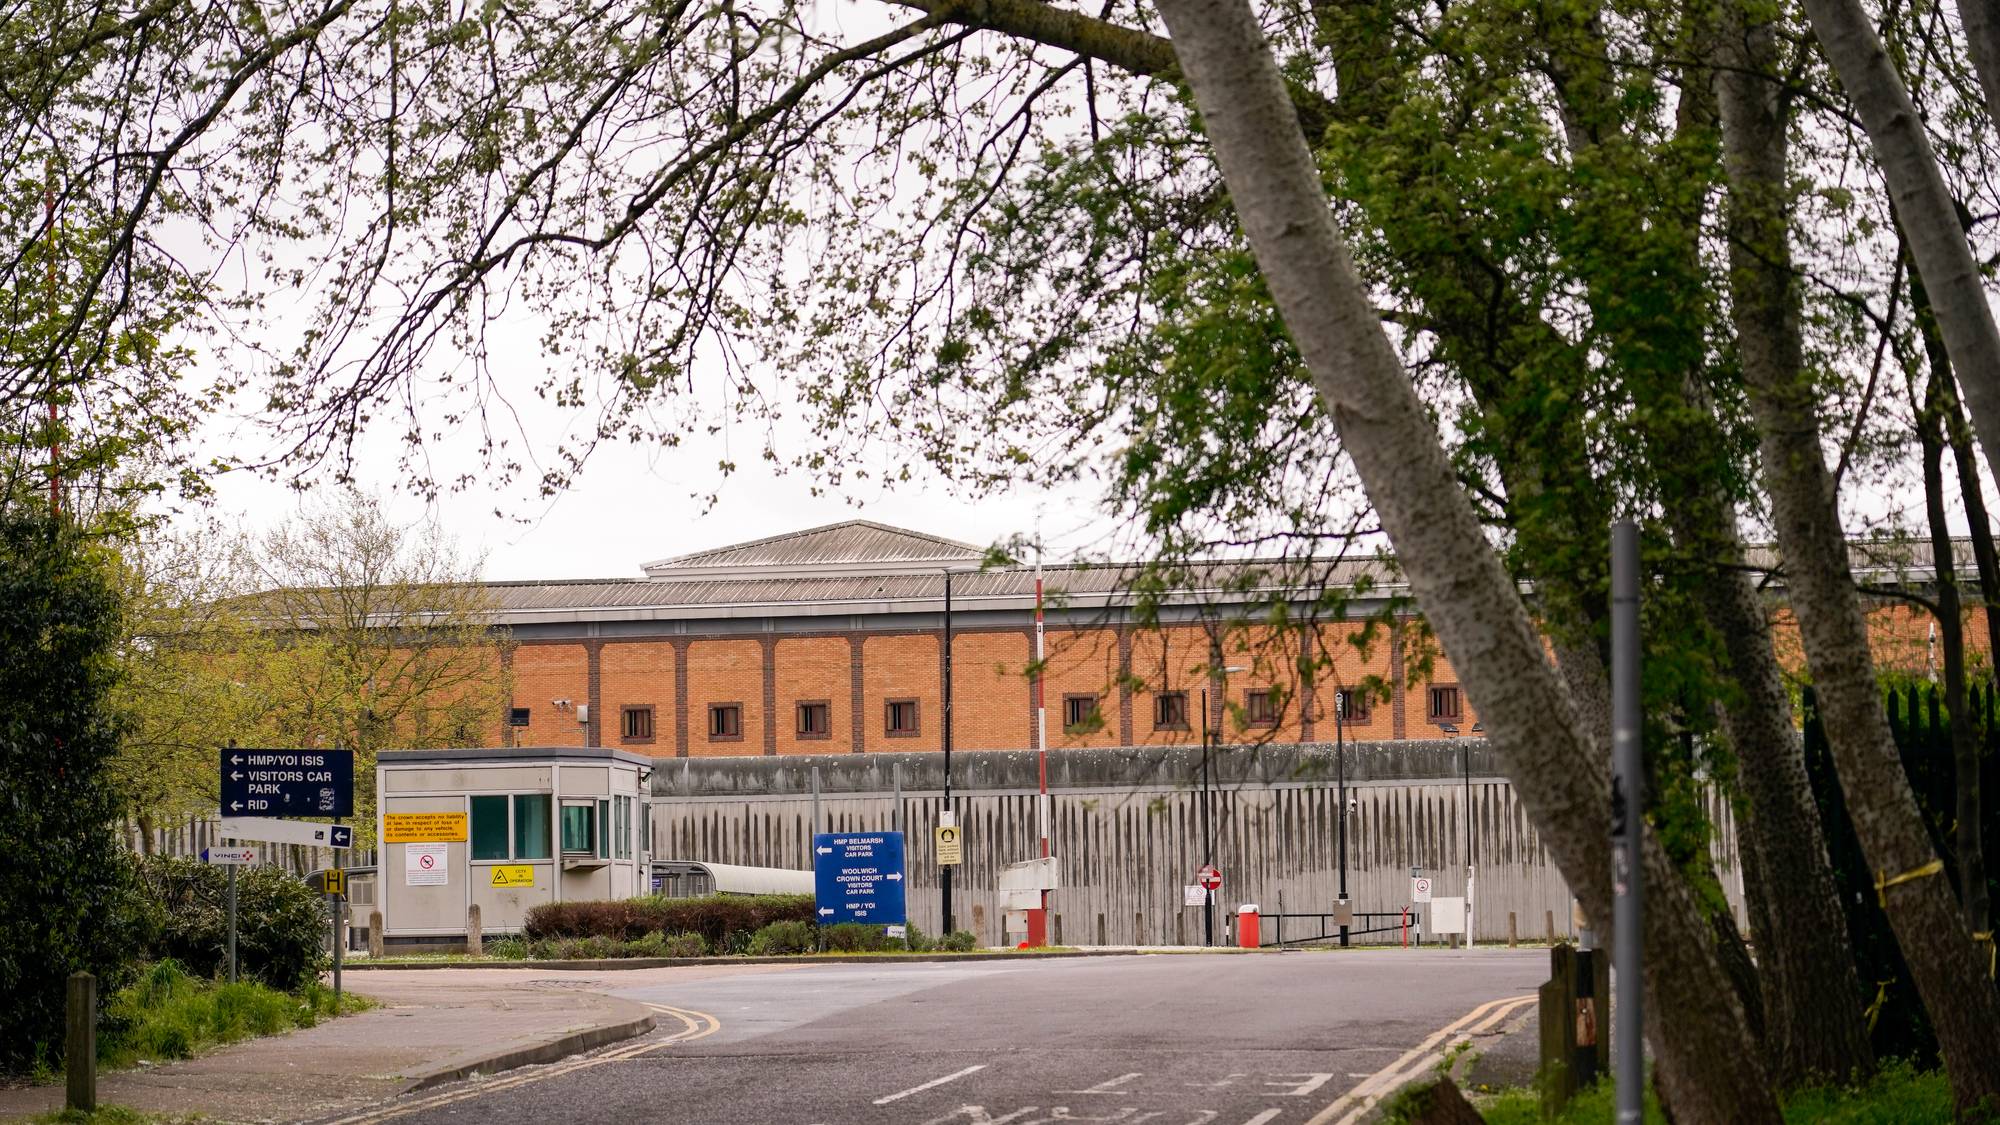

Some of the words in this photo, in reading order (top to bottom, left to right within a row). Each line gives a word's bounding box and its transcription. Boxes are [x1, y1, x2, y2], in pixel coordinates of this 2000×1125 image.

[248, 755, 297, 766] HMP/YOI
[301, 755, 325, 766] ISIS
[248, 771, 303, 782] VISITORS
[307, 771, 332, 782] CAR
[248, 784, 280, 794] PARK
[248, 799, 268, 810] RID
[849, 837, 884, 845] BELMARSH
[327, 871, 340, 890] H
